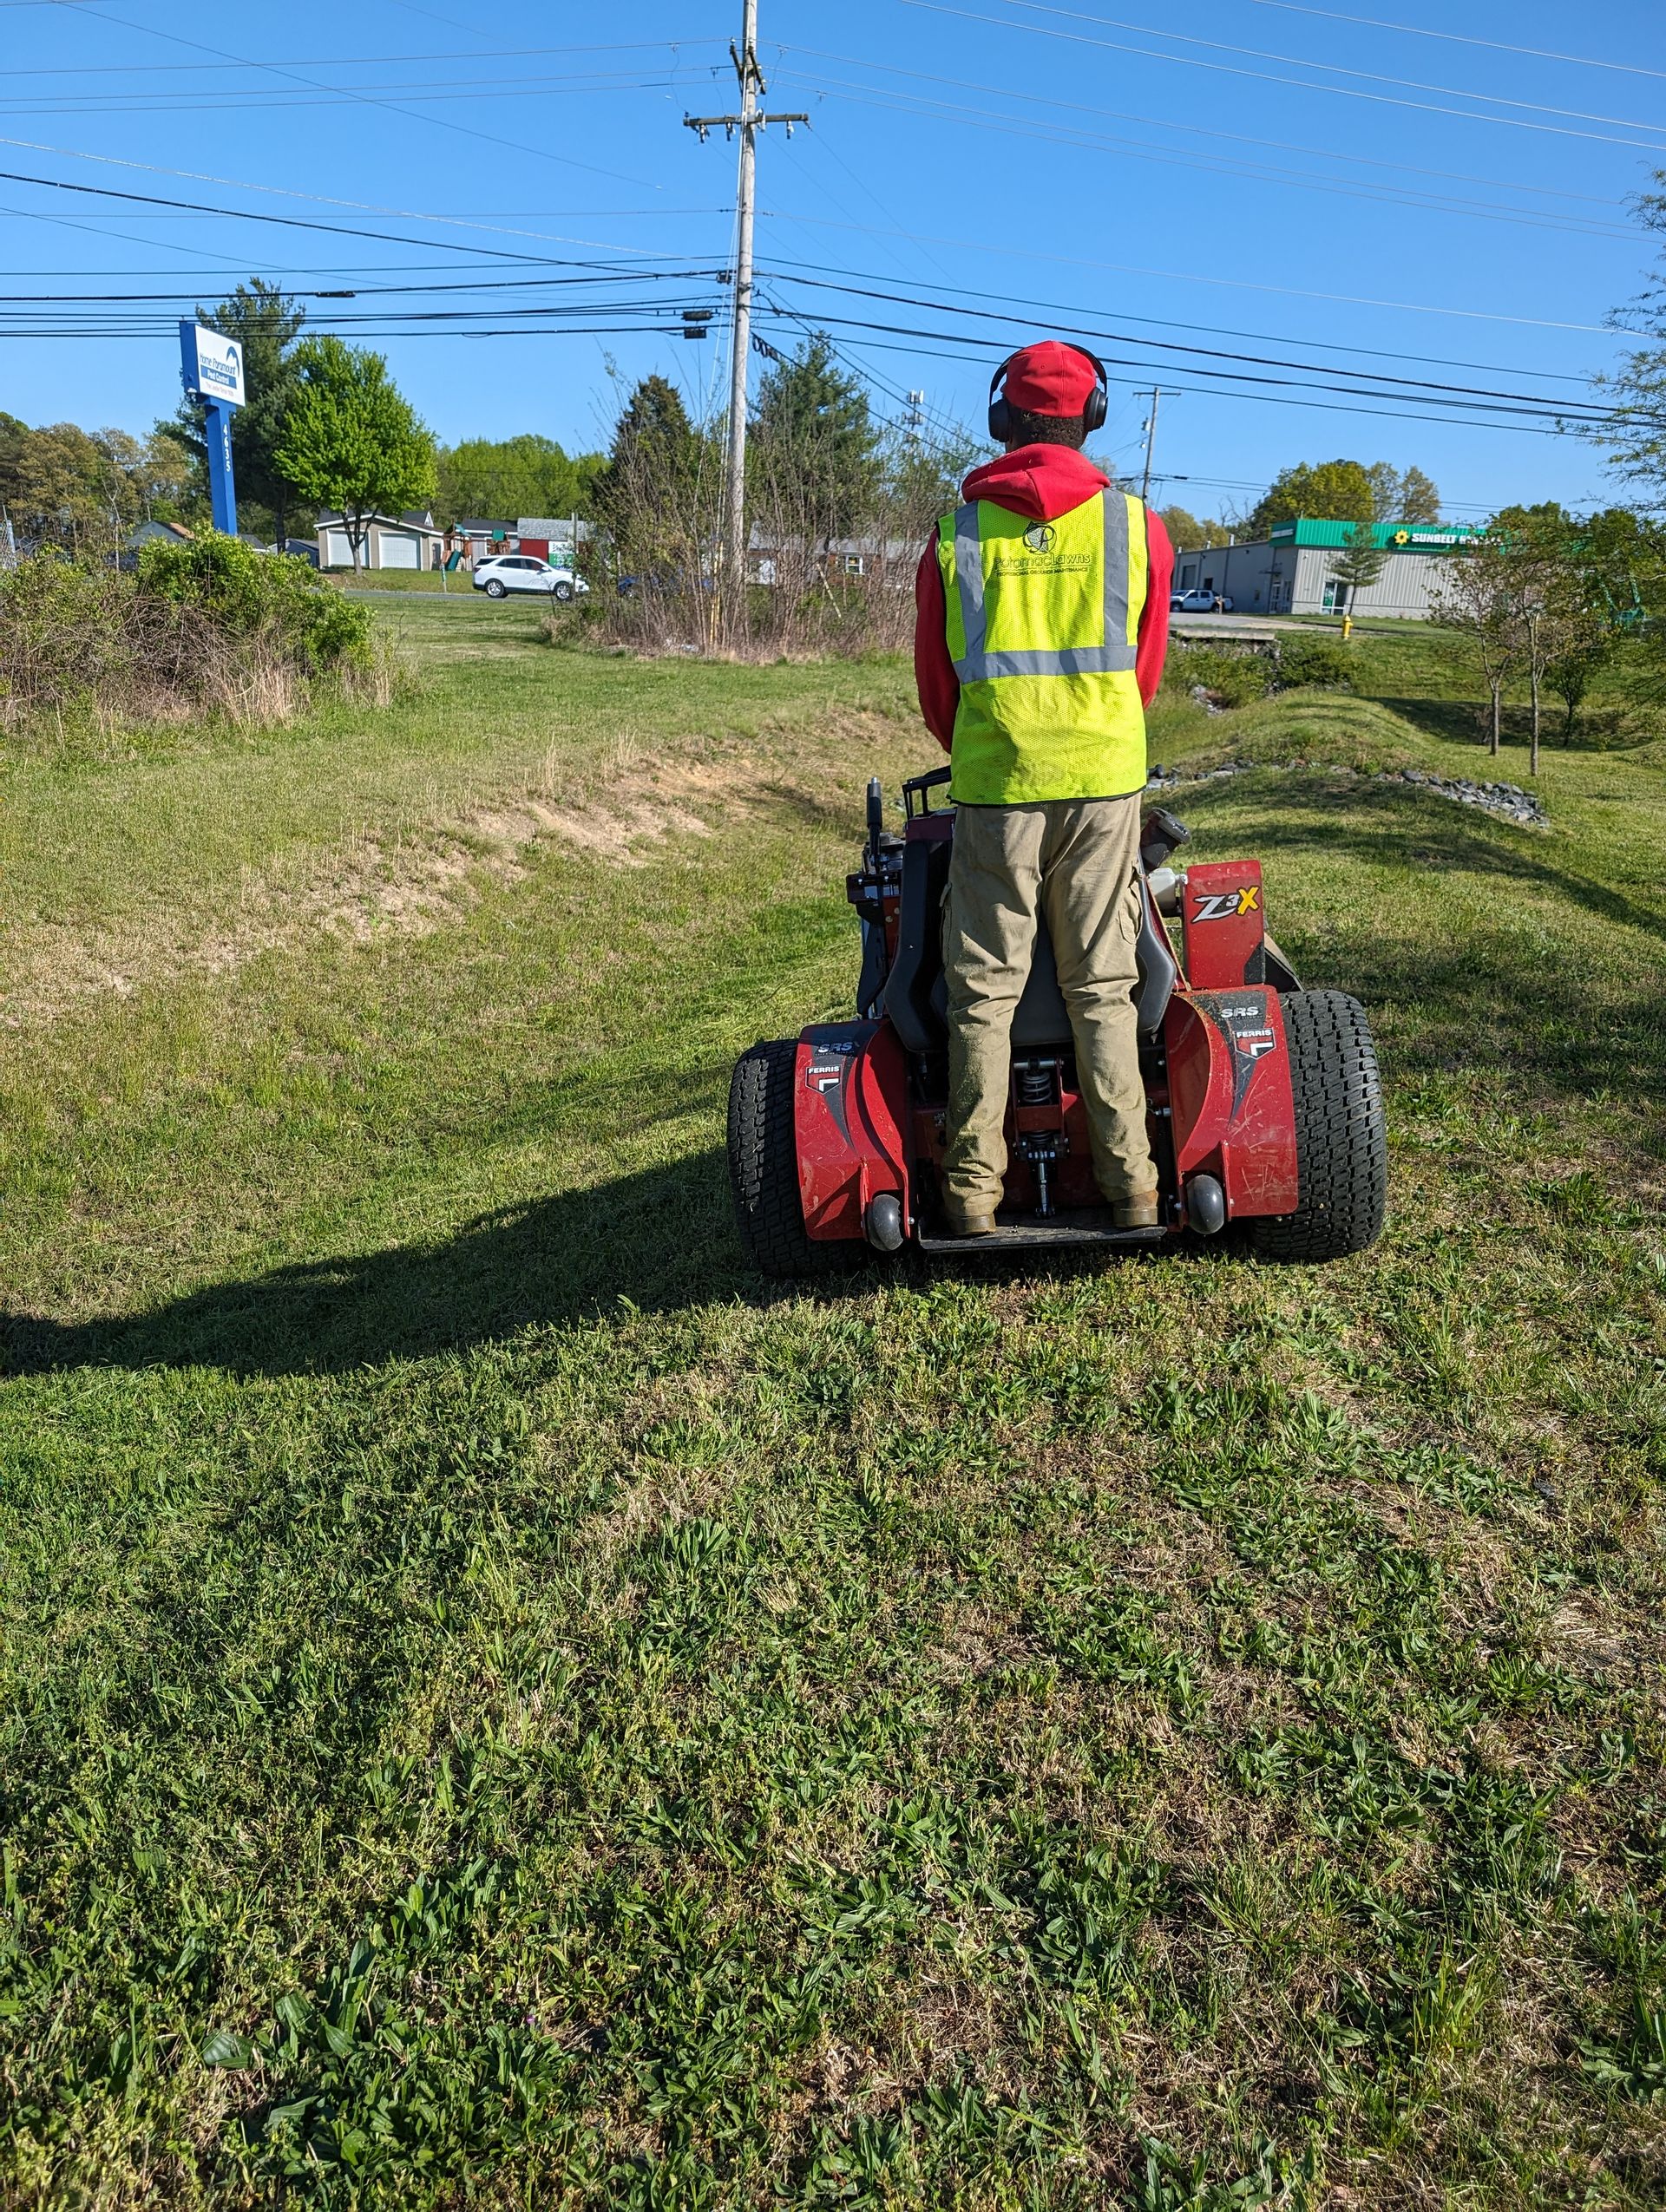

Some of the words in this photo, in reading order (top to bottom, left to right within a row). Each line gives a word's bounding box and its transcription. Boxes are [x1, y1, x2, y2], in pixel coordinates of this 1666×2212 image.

[1411, 533, 1457, 545] SUNBELT
[1220, 1006, 1259, 1018] SRS
[1236, 1029, 1272, 1038] FERRIS
[817, 1041, 853, 1053] SRS
[808, 1065, 840, 1074] FERRIS
